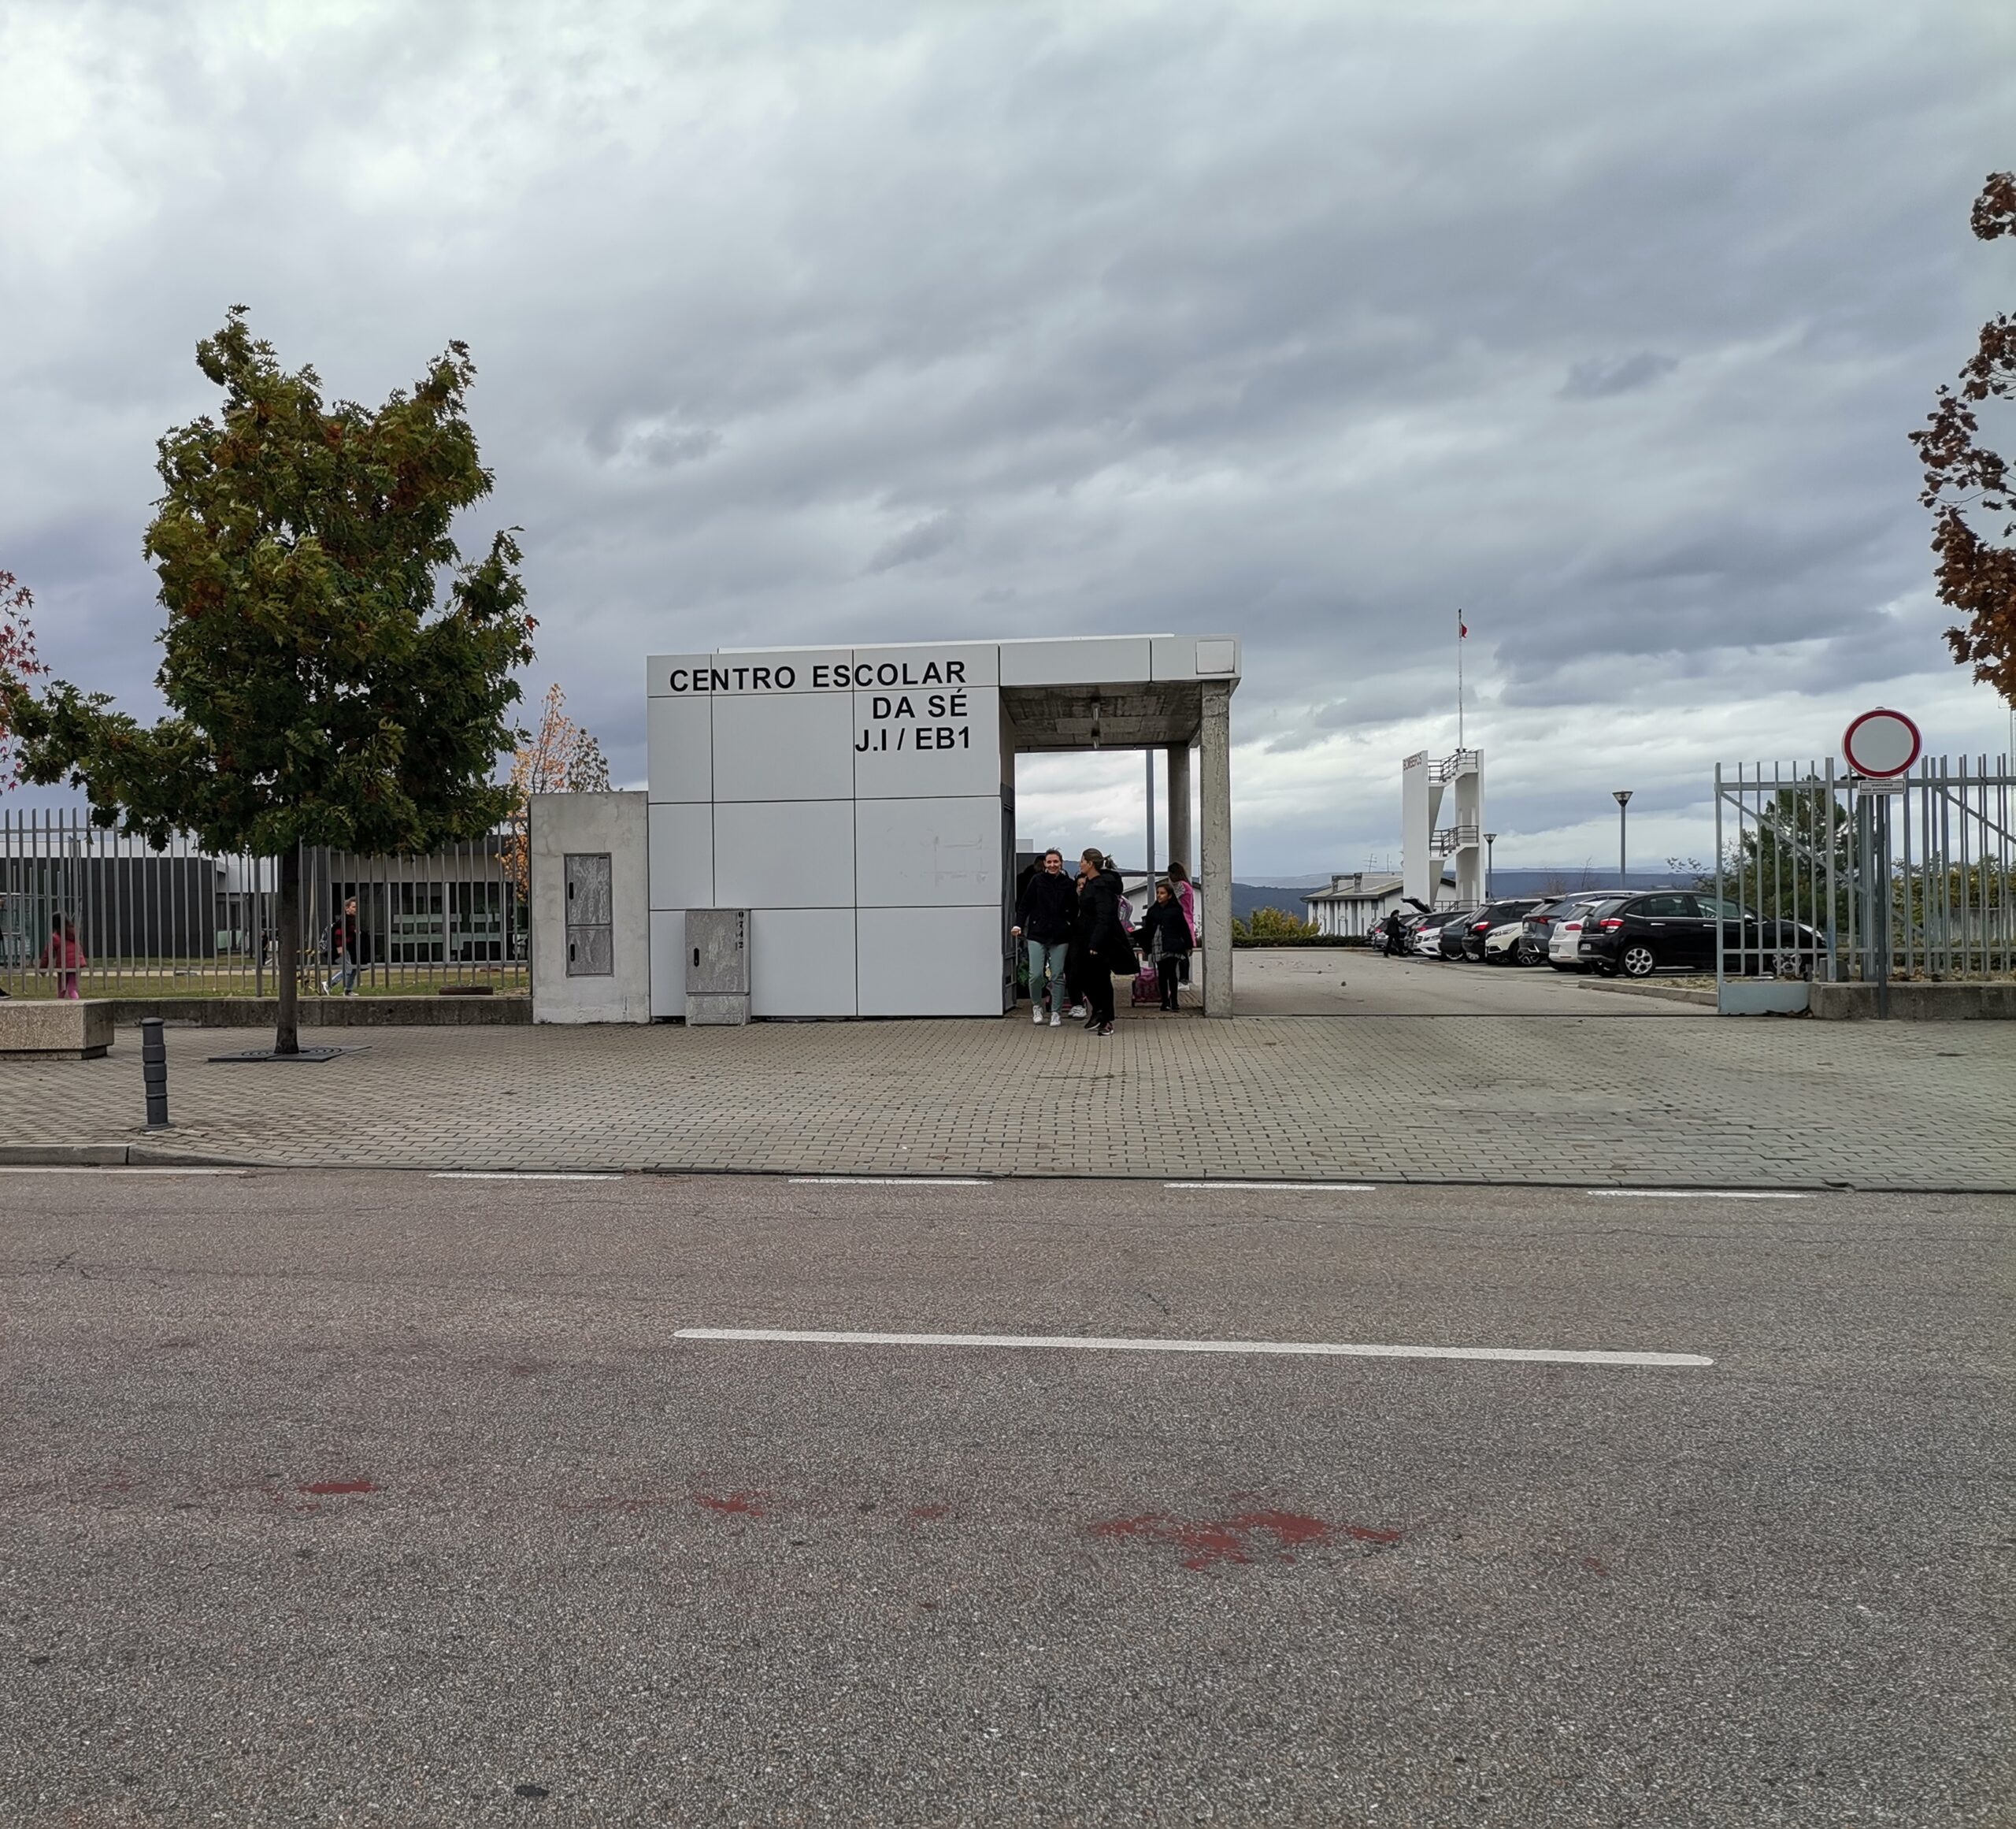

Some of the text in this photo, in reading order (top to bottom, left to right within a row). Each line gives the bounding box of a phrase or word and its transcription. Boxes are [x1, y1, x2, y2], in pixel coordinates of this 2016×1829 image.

[669, 661, 965, 692] CENTRO ESCOLAR
[873, 688, 968, 719] DA SÉ
[854, 729, 887, 752] J.I
[916, 726, 969, 750] EB1
